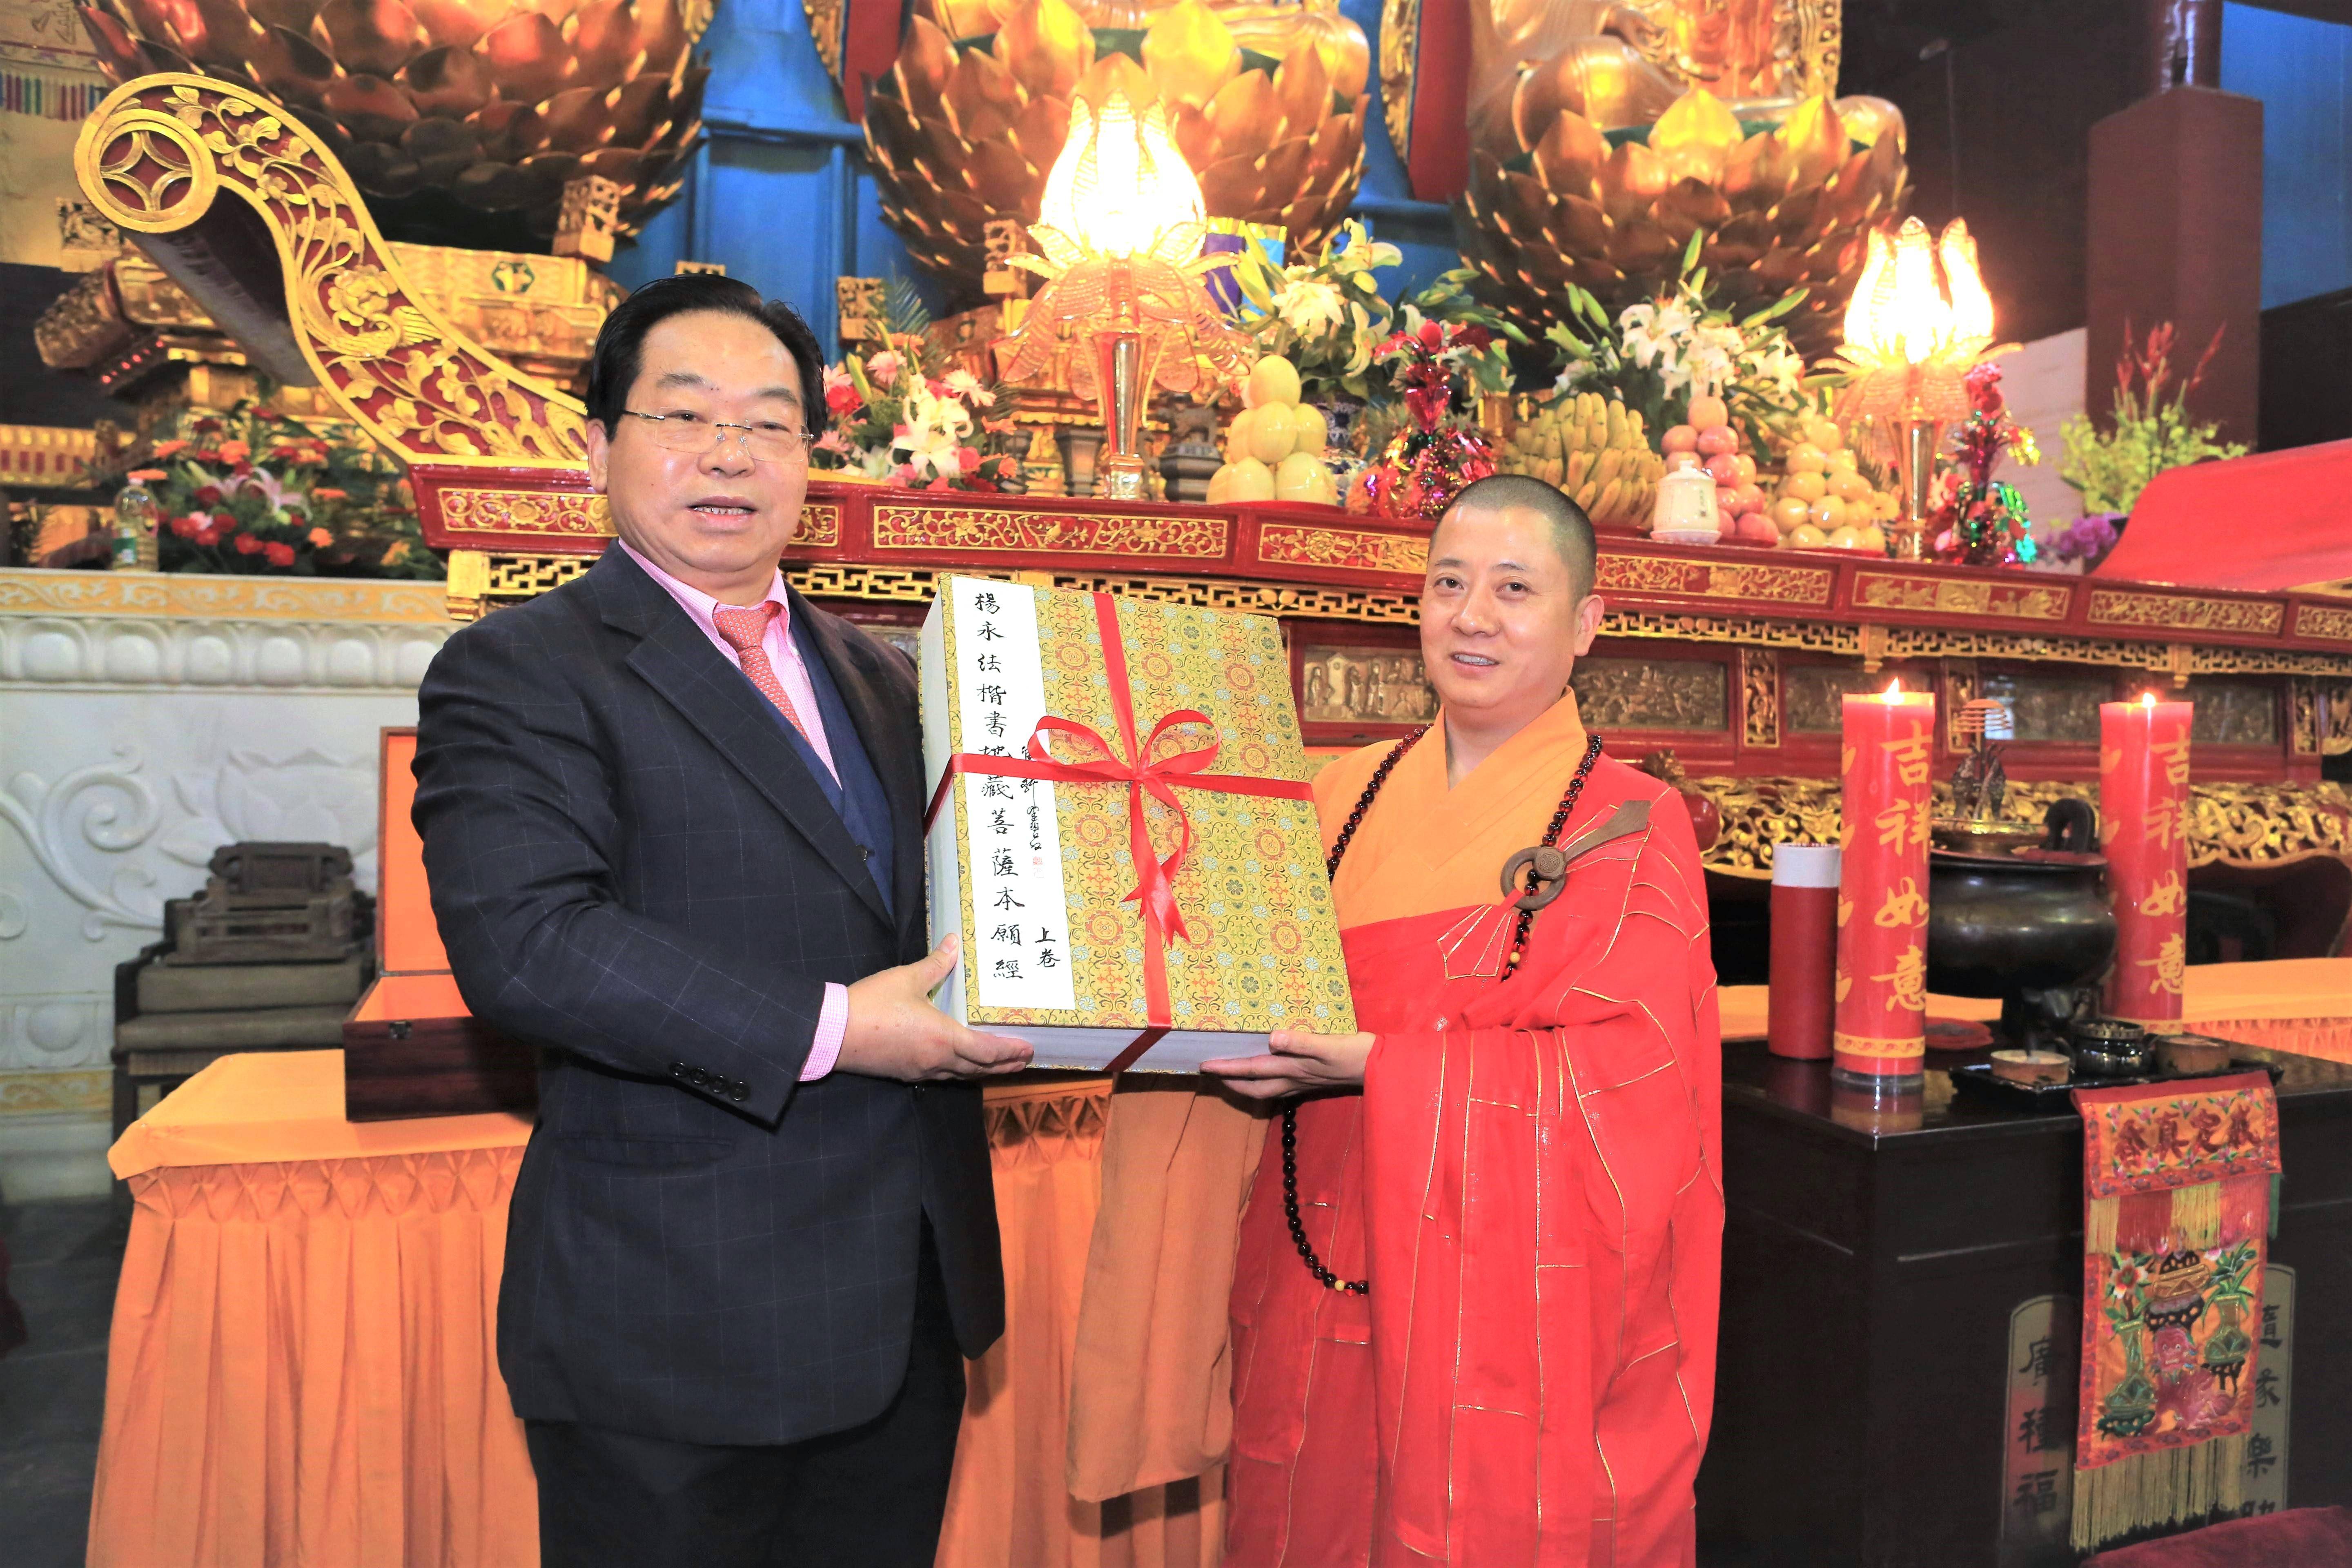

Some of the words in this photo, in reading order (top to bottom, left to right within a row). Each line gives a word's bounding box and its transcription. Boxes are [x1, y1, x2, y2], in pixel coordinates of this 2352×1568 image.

[1035, 927, 1061, 968] 上卷
[1870, 719, 1934, 1011] 吉祥如意
[2136, 724, 2191, 994] 吉祥如意
